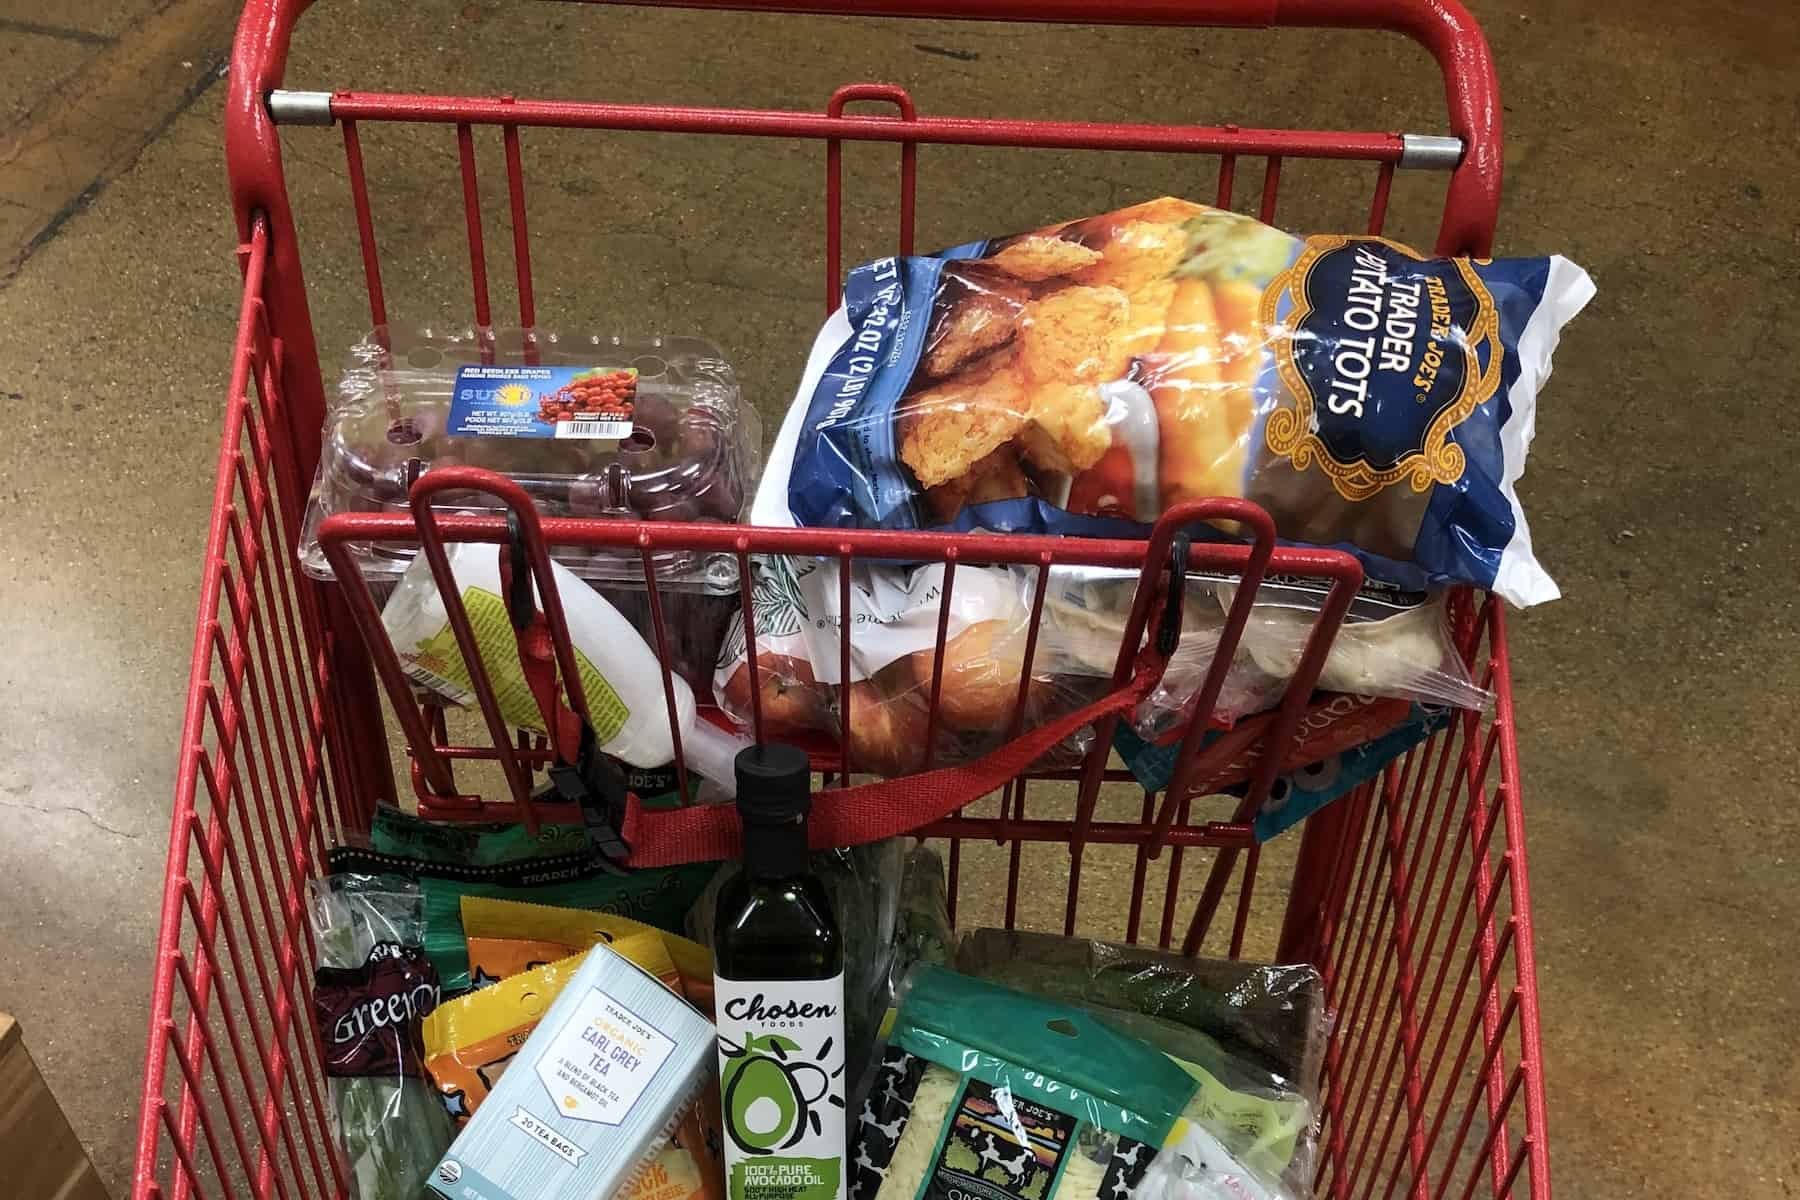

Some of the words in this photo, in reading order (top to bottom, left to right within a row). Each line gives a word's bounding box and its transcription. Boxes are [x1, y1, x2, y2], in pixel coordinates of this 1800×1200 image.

[1343, 247, 1388, 331] POTATO
[1424, 275, 1453, 341] TRADER
[853, 327, 881, 352] OZ
[1378, 282, 1421, 373] TRADER
[1328, 337, 1377, 418] TOTS
[1412, 340, 1445, 392] JOE'S
[724, 993, 837, 1021] Chosen
[581, 1025, 611, 1055] EARL
[609, 1045, 642, 1072] GREY
[587, 1052, 611, 1077] TEA
[1025, 1102, 1056, 1121] JOE'S
[521, 1116, 534, 1130] 20
[532, 1122, 553, 1143] TEA
[550, 1134, 576, 1159] BAGS
[744, 1164, 778, 1176] 100%
[778, 1164, 812, 1176] PURE
[744, 1175, 802, 1186] AVOCADO
[803, 1175, 825, 1186] OIL
